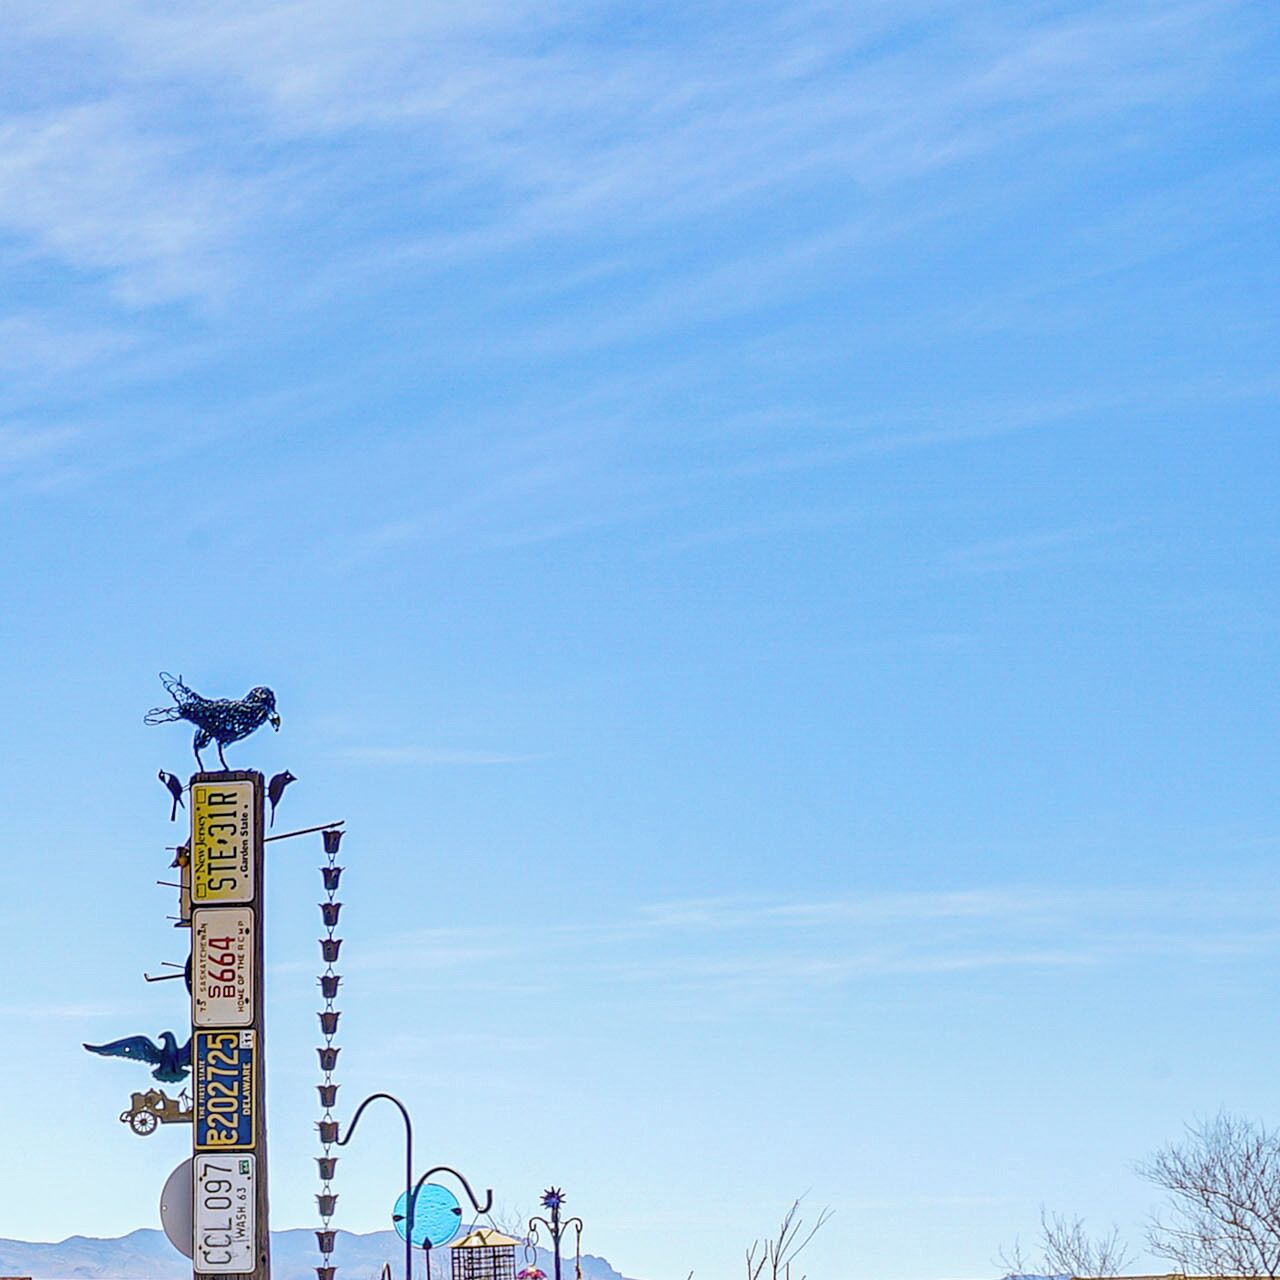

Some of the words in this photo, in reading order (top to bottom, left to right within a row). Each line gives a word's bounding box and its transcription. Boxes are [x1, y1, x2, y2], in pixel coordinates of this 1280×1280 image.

[195, 815, 207, 846] Jersey
[208, 792, 237, 836] 31R
[195, 848, 205, 873] New
[208, 846, 237, 891] STE
[238, 974, 244, 985] OF
[207, 1034, 238, 1128] 202725
[243, 1063, 251, 1115] DELAWARE
[204, 1163, 232, 1210] 097
[237, 1187, 246, 1200] 63
[204, 1217, 232, 1264] CCL
